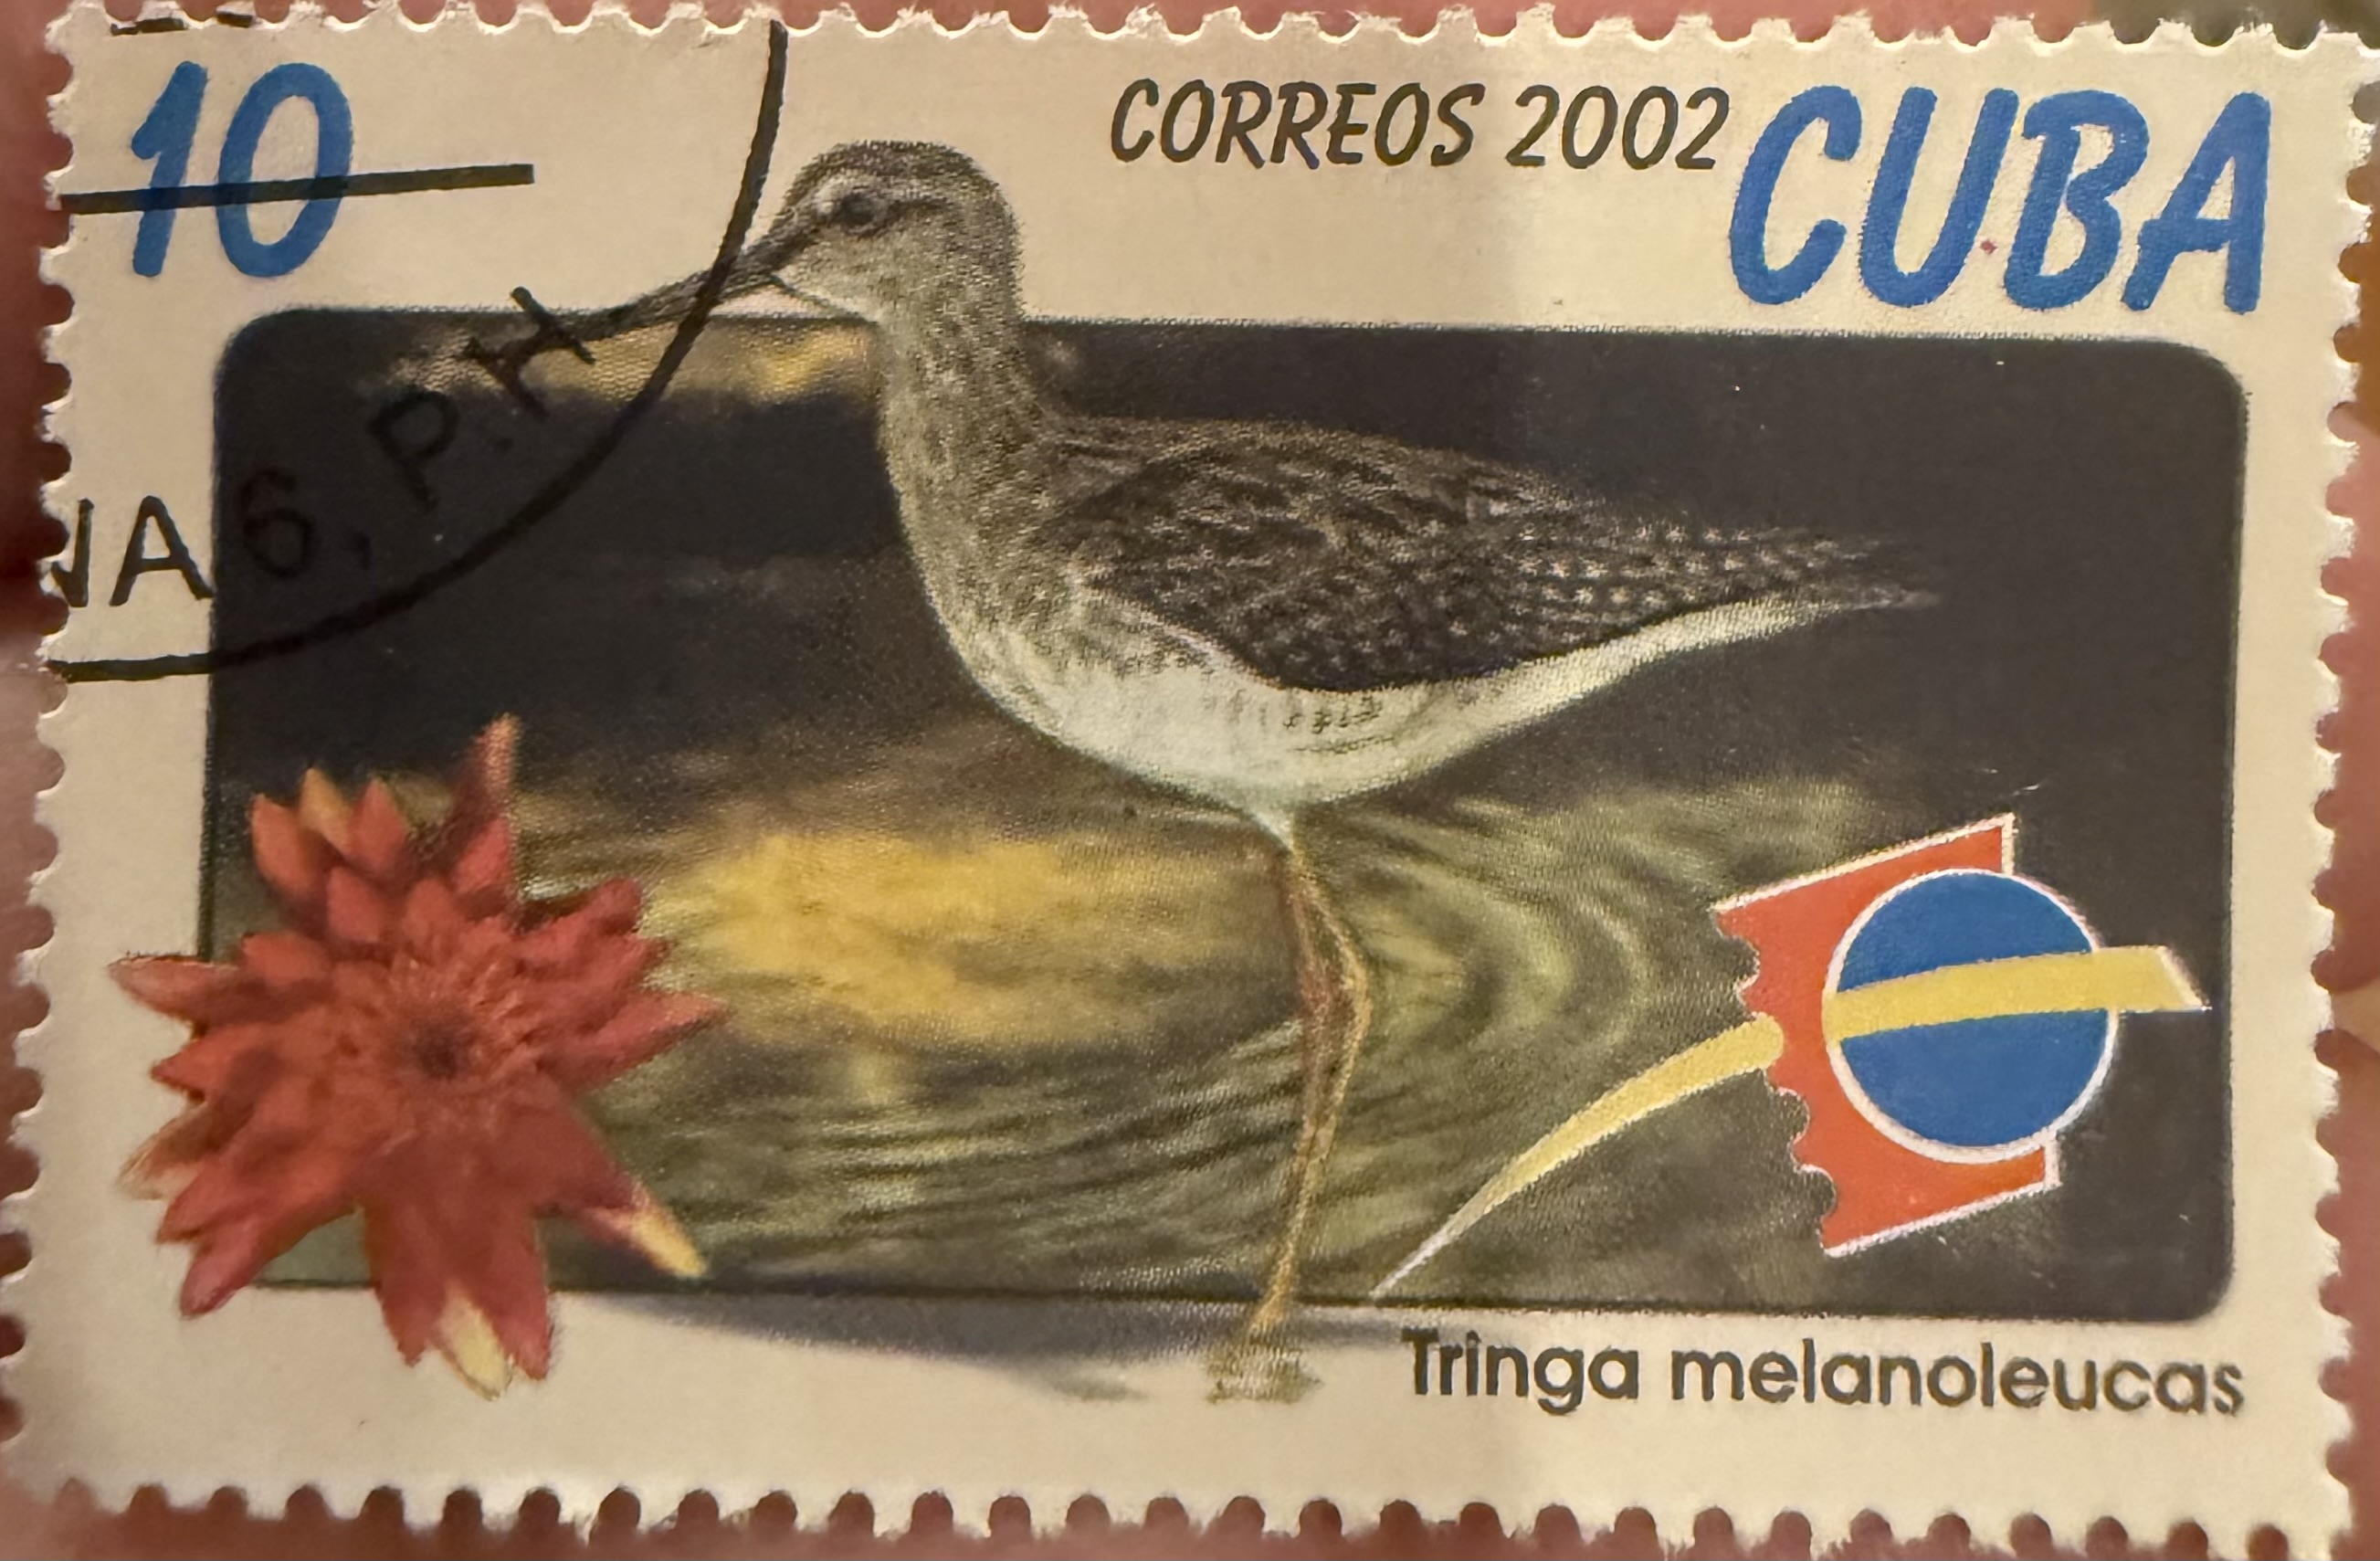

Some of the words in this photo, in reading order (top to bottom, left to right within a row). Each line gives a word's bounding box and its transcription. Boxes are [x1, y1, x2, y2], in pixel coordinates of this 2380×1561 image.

[131, 60, 353, 278] 10
[1110, 79, 1486, 169] CORREOS
[1506, 83, 1731, 170] 2002
[1729, 84, 2272, 315] CUBA
[1401, 1326, 1640, 1415] Tringa
[1670, 1338, 2246, 1418] melanoleucas
